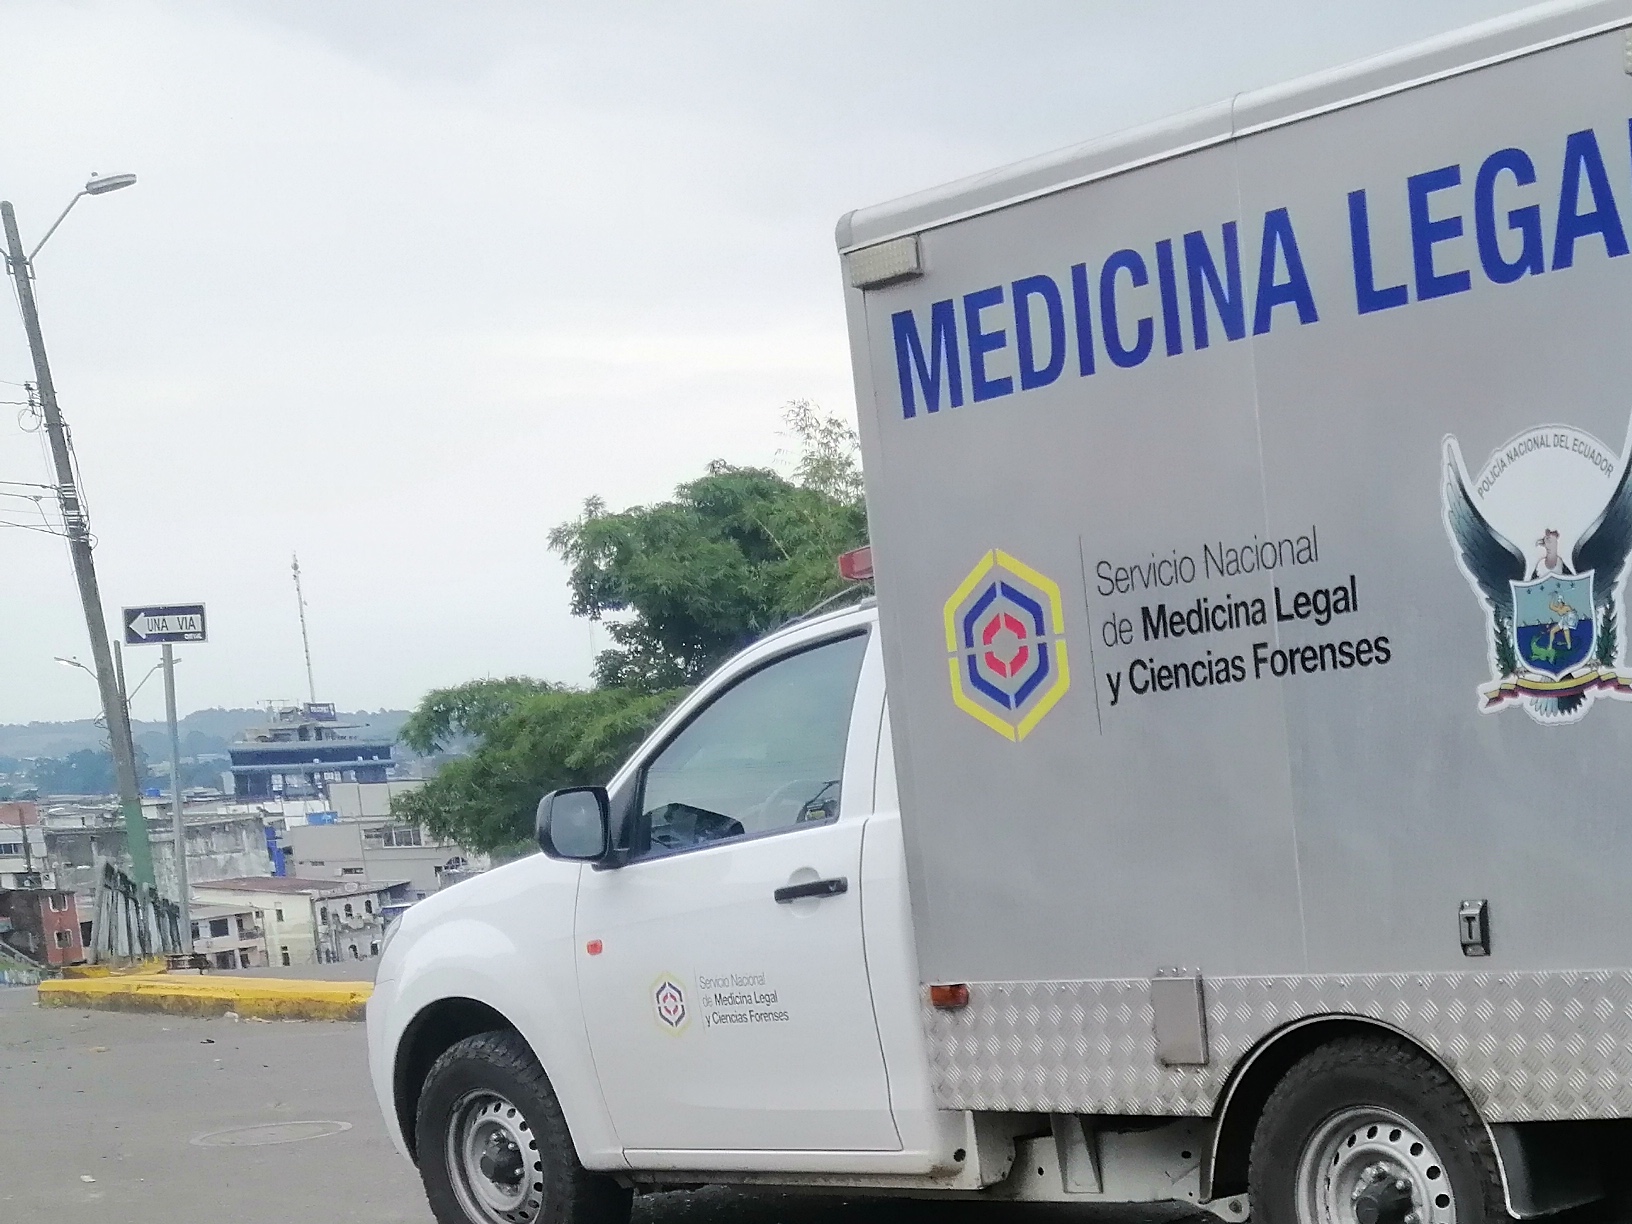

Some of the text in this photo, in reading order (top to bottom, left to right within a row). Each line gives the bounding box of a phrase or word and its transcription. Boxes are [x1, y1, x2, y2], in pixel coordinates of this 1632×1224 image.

[892, 206, 1319, 420] MEDICINA
[1506, 434, 1551, 465] NACIONAL
[1553, 433, 1570, 450] DEL
[1571, 438, 1614, 479] ECUADOR
[1096, 524, 1319, 597] Servicio Nacional
[147, 616, 197, 632] UNA VIA
[1102, 574, 1358, 647] de Medicina Legal
[1106, 635, 1391, 706] y Ciencias Forenses
[699, 972, 766, 990] Servicio Nacional
[702, 990, 778, 1007] de Medicina Legal
[705, 1010, 790, 1028] y Ciencias Forenses
